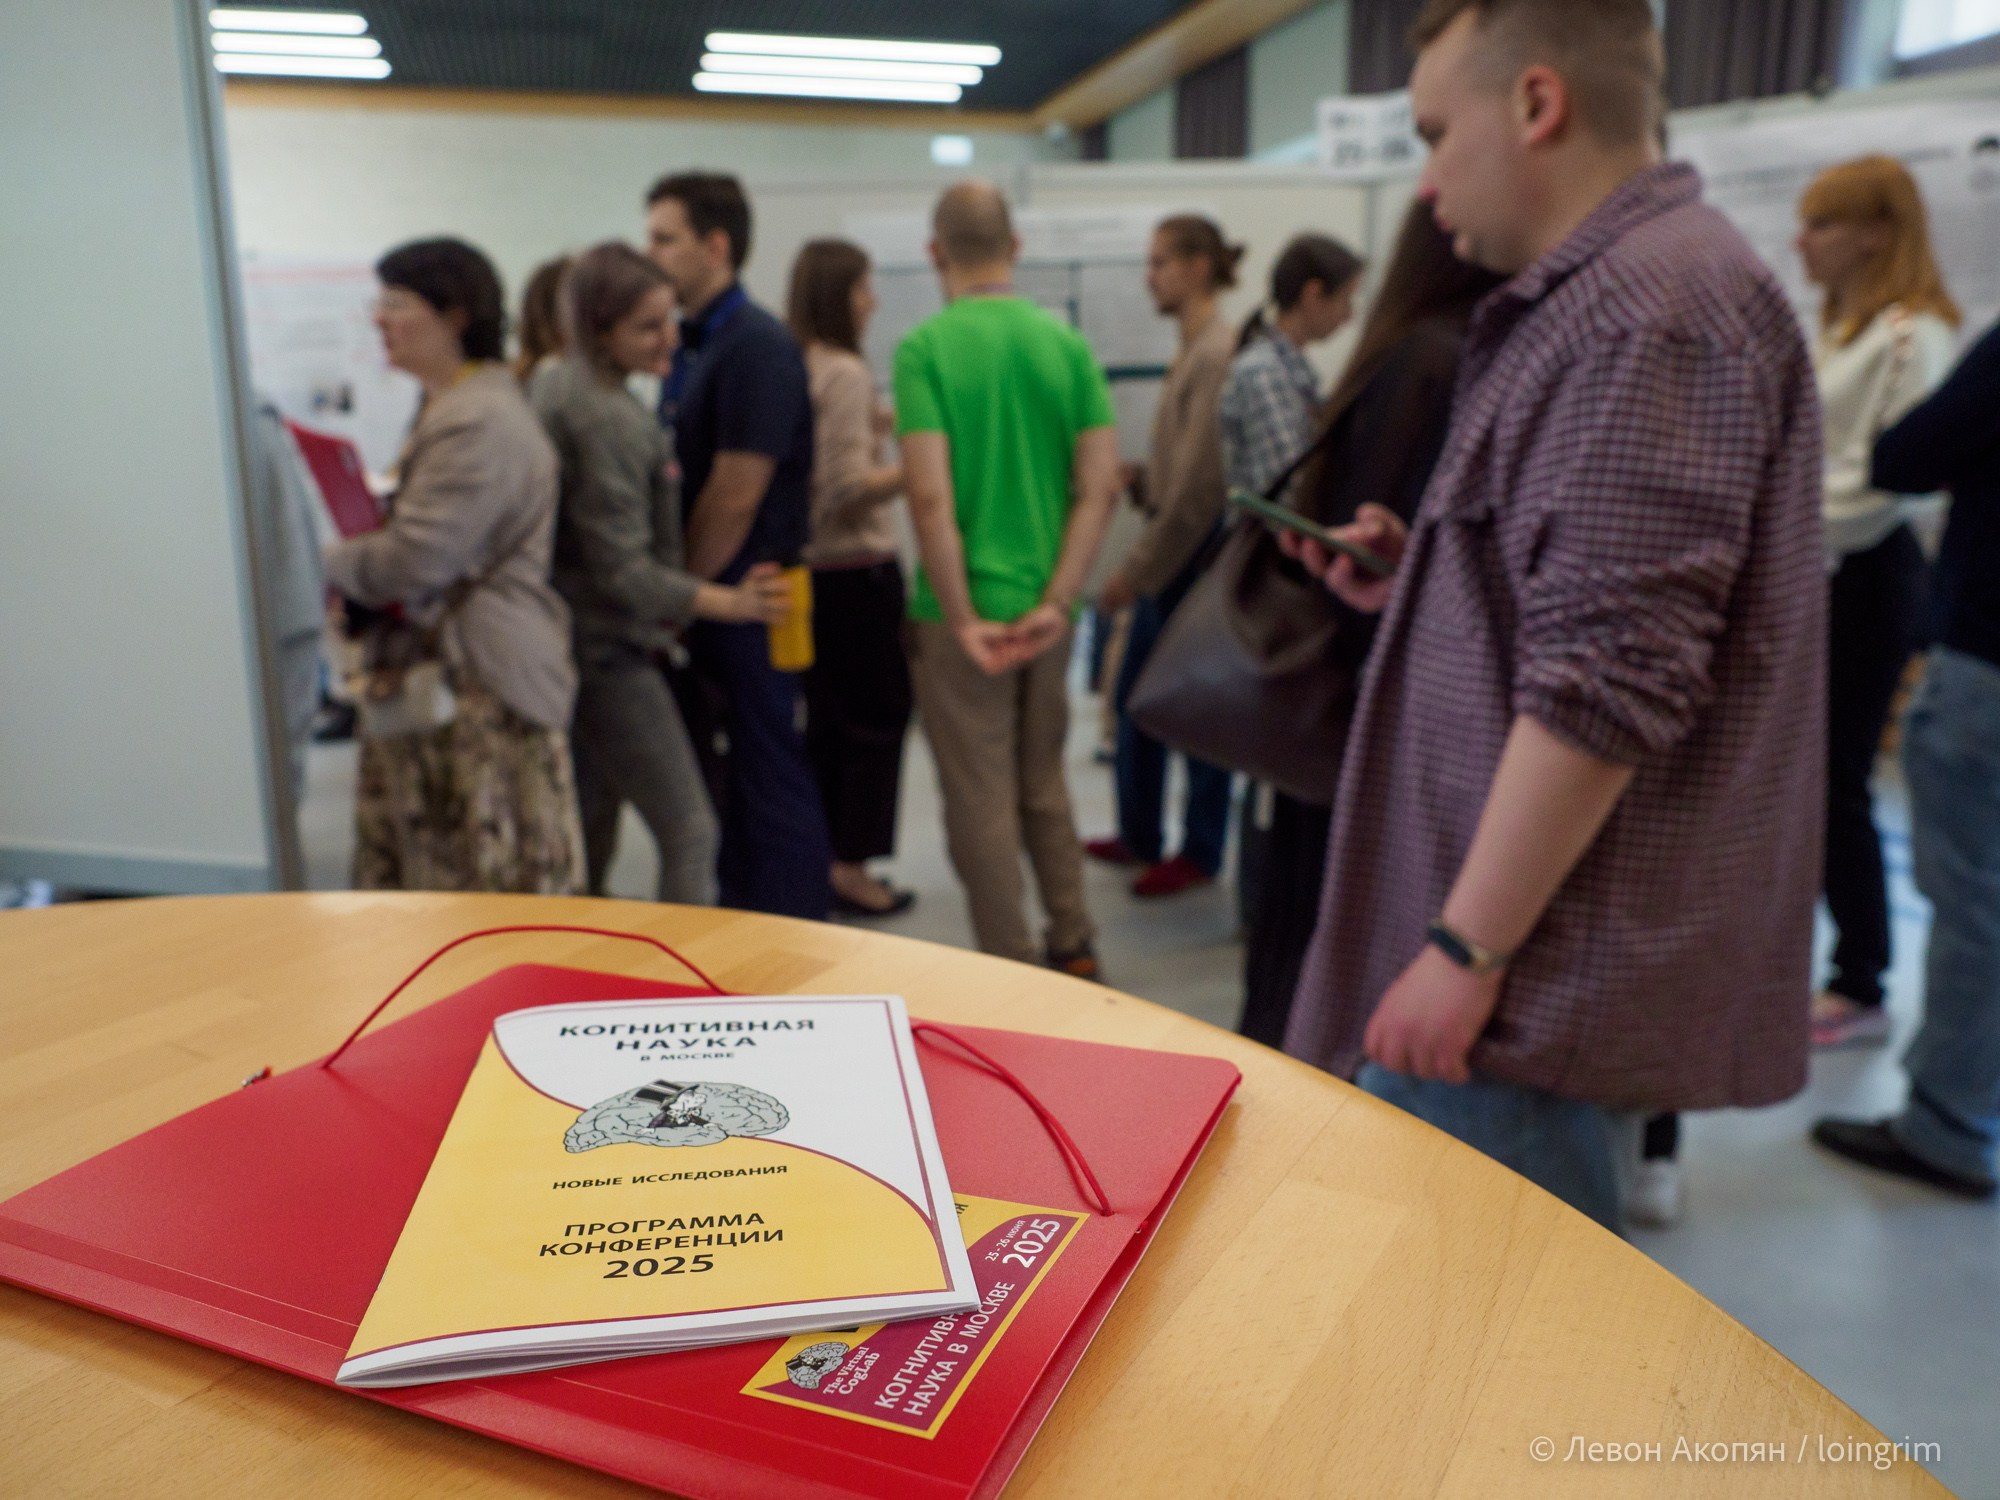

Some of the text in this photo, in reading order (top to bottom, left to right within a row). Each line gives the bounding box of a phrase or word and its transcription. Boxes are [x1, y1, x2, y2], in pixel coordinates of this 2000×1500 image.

[559, 1019, 815, 1036] КОГНИТИВНАЯ
[616, 1037, 757, 1050] НАУКА
[660, 1052, 735, 1061] МОСКВЕ
[552, 1165, 788, 1190] НОВЫЕ ИССЛЕДОВАНИЯ
[564, 1212, 765, 1237] ПРОГРАММА
[539, 1229, 784, 1257] КОНФЕРЕНЦИИ
[984, 1251, 1000, 1262] 25
[996, 1238, 1011, 1248] 26
[1002, 1218, 1061, 1268] 2025
[603, 1253, 714, 1279] 2025
[902, 1281, 1016, 1416] НАУКА В МОСКВЕ
[823, 1346, 870, 1395] The Virtual
[838, 1352, 880, 1395] CogLab
